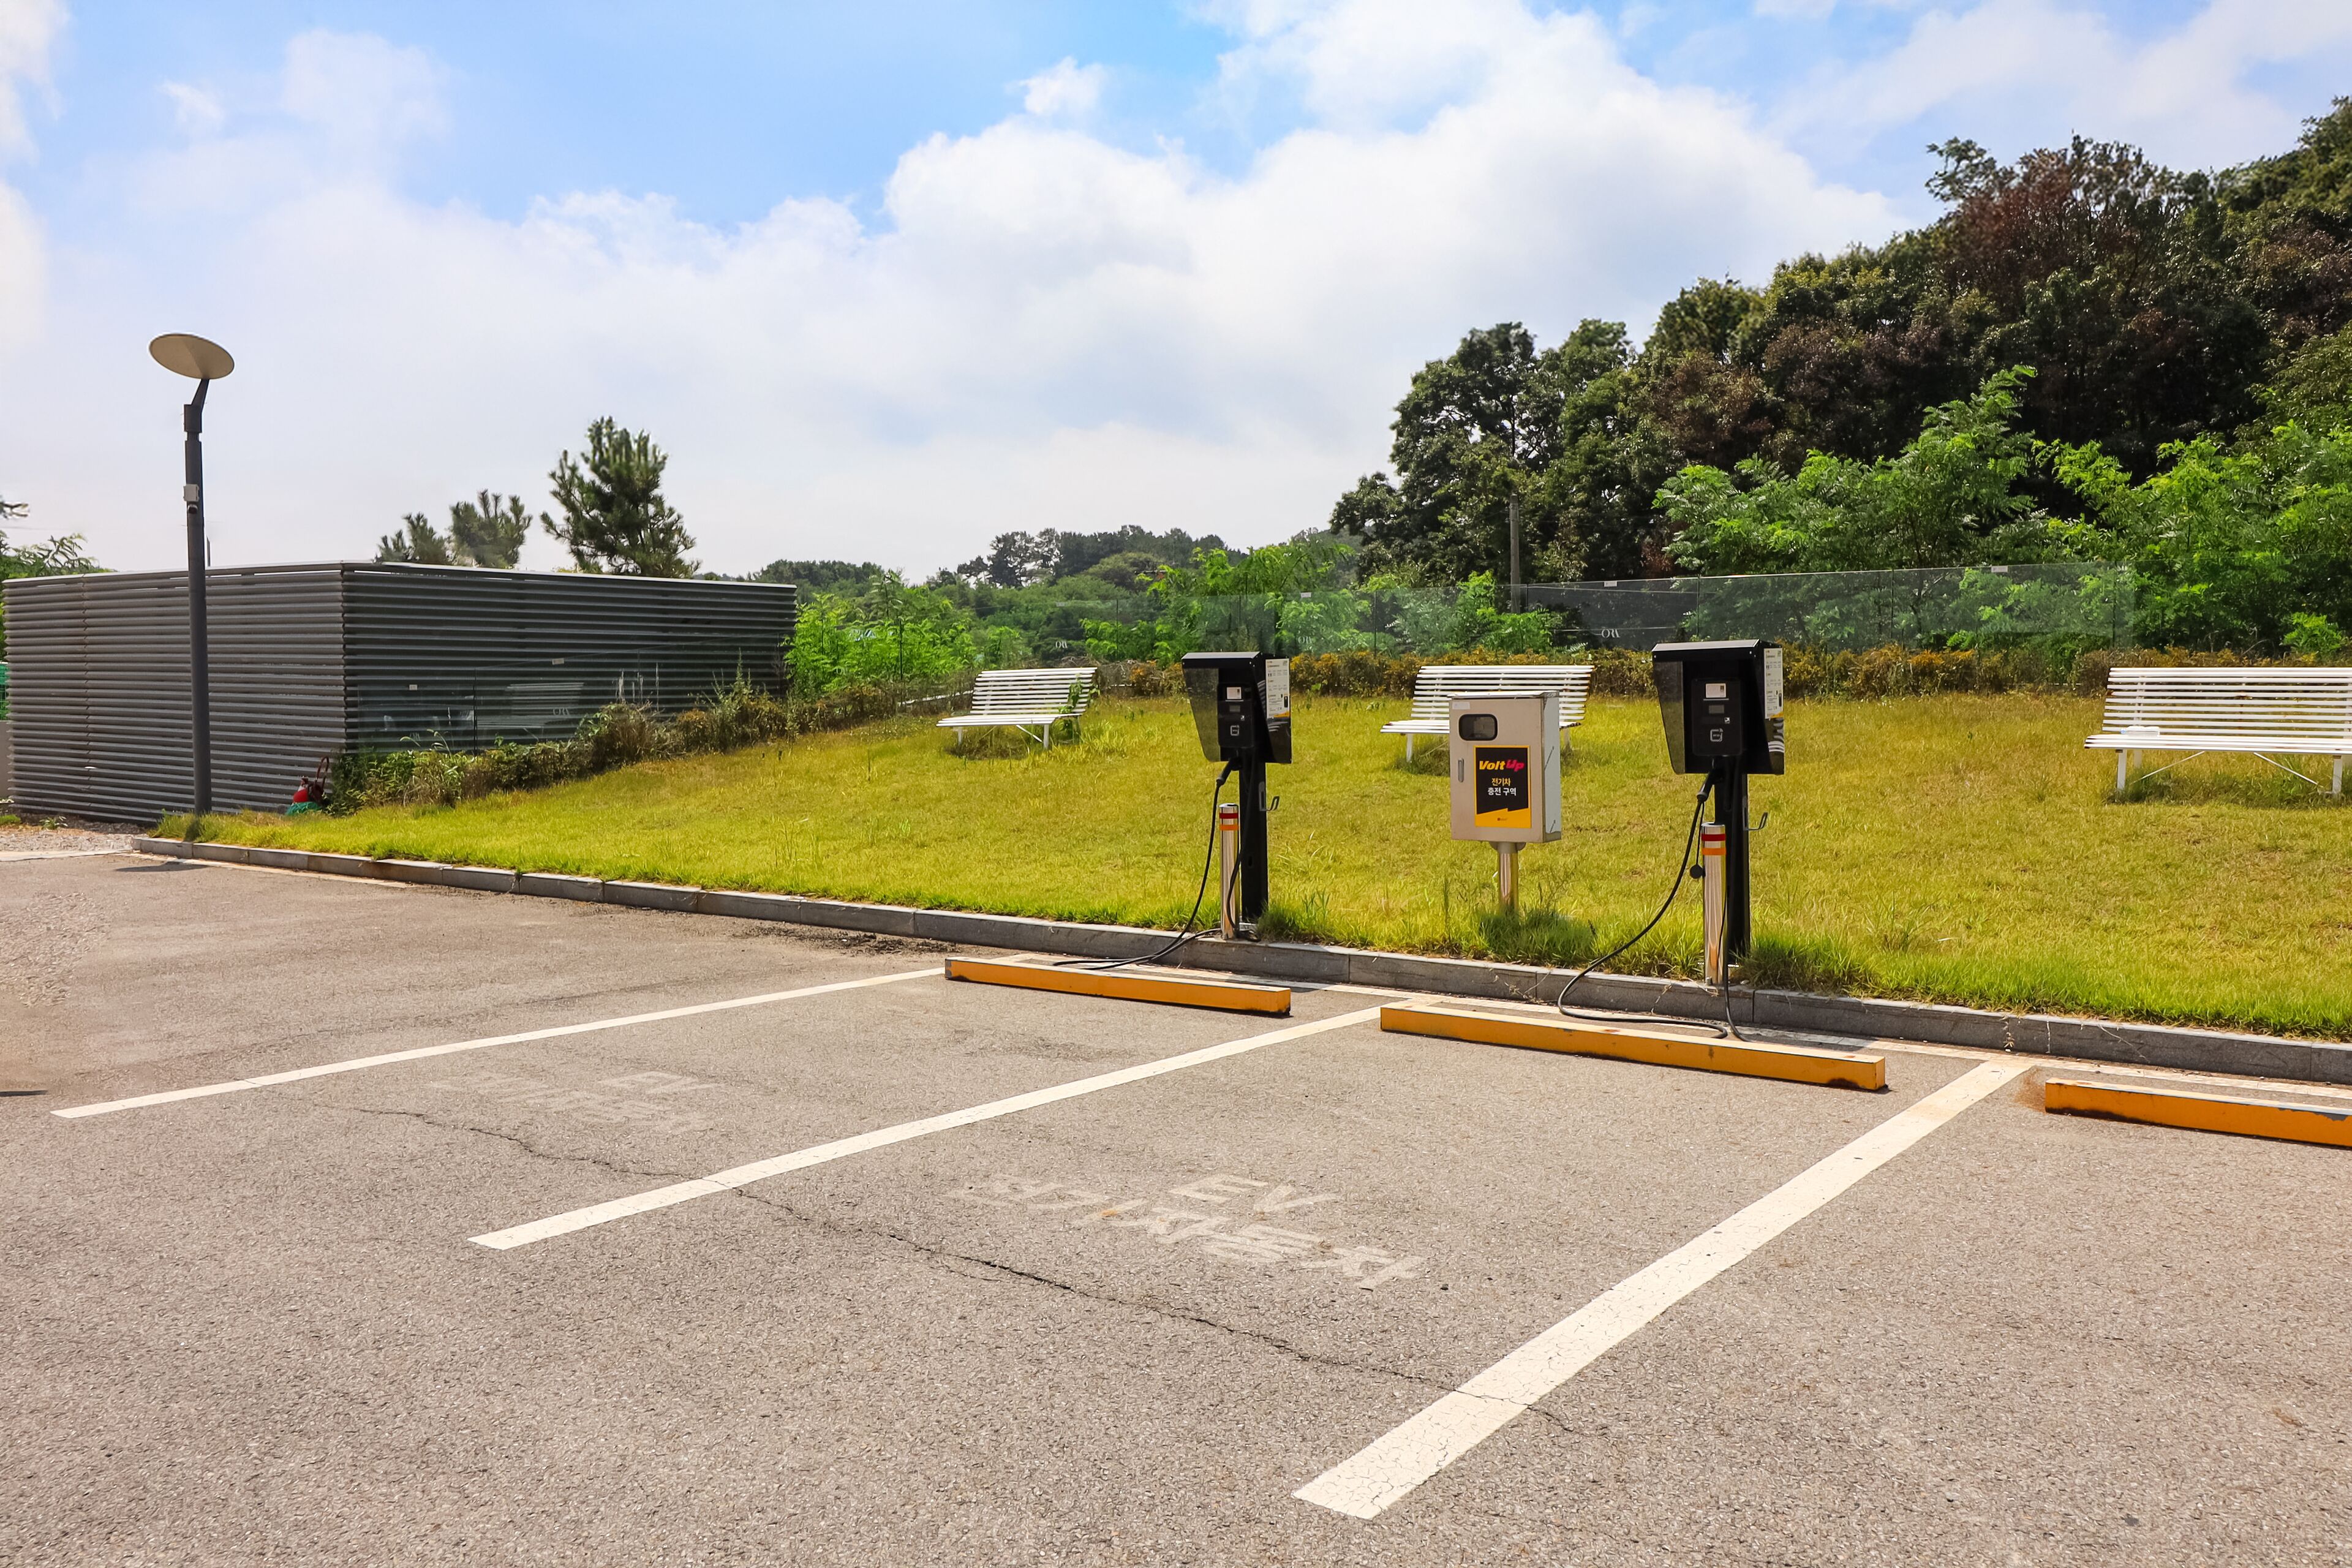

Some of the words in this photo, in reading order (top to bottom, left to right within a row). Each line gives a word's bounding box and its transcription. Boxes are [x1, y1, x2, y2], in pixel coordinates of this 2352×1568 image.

[1487, 787, 1501, 796] 충전
[1502, 787, 1517, 796] 구역
[1491, 778, 1511, 786] 전기차
[595, 1070, 726, 1095] EV
[1166, 1174, 1341, 1213] EV
[944, 1172, 1422, 1291] 전기자동차
